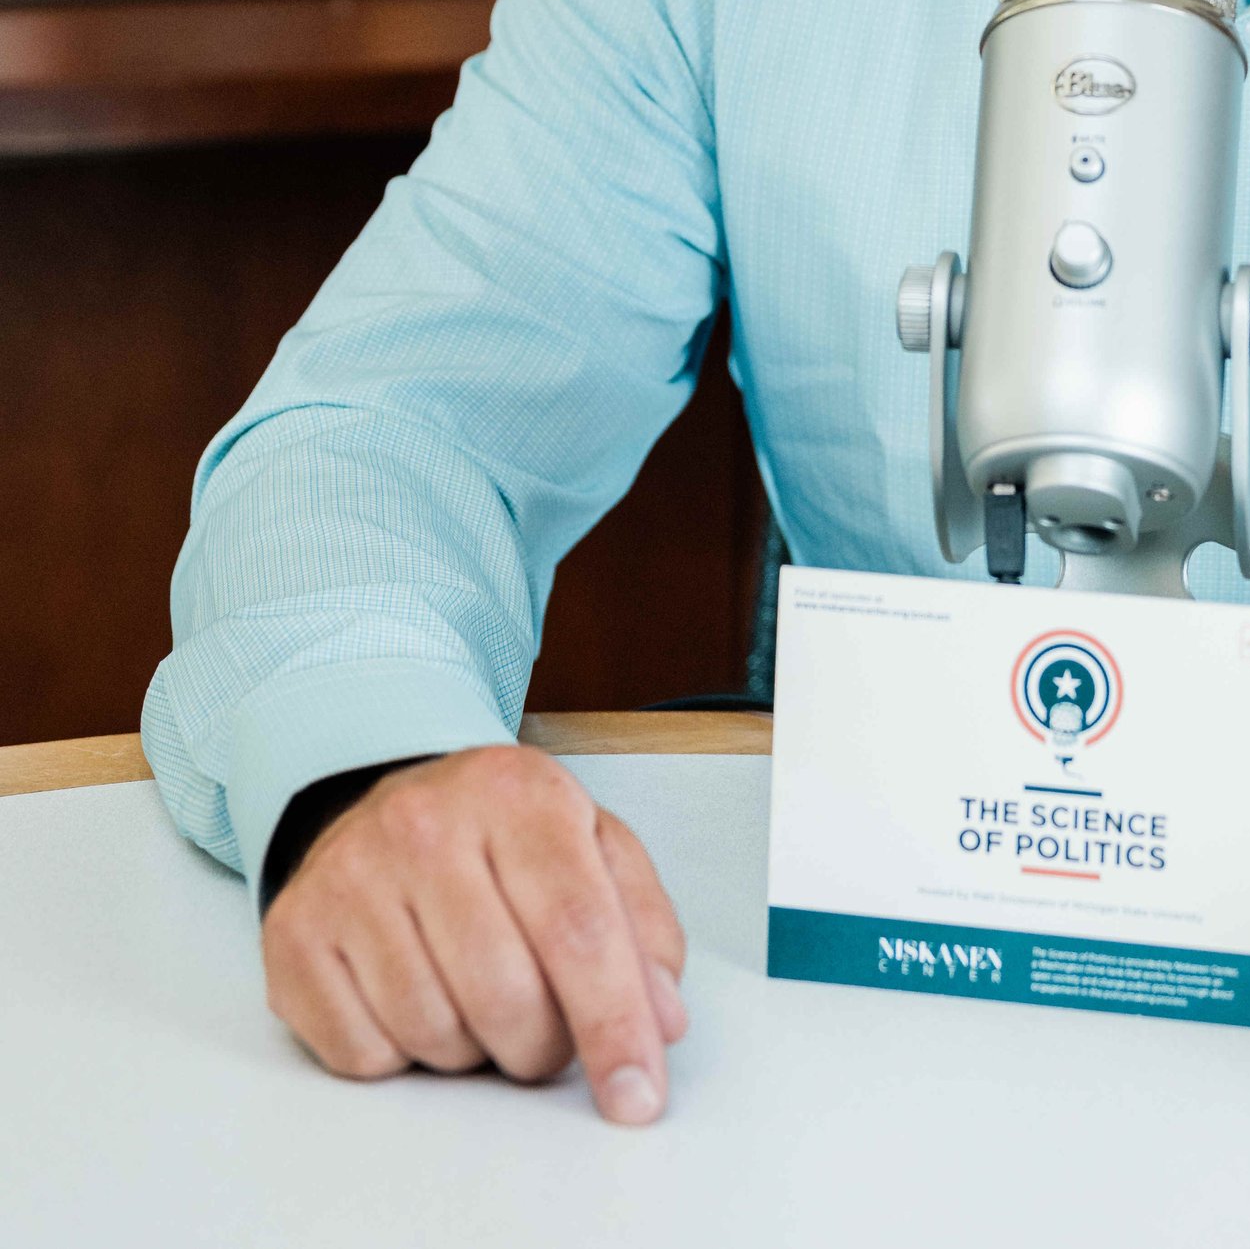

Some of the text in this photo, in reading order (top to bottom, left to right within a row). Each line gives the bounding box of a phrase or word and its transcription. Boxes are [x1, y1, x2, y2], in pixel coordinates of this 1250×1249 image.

[959, 797, 1167, 839] THE SCIENCE
[957, 828, 1167, 870] OF POLITICS
[878, 936, 1003, 970] NISKANEN
[878, 958, 1002, 984] CENTER
